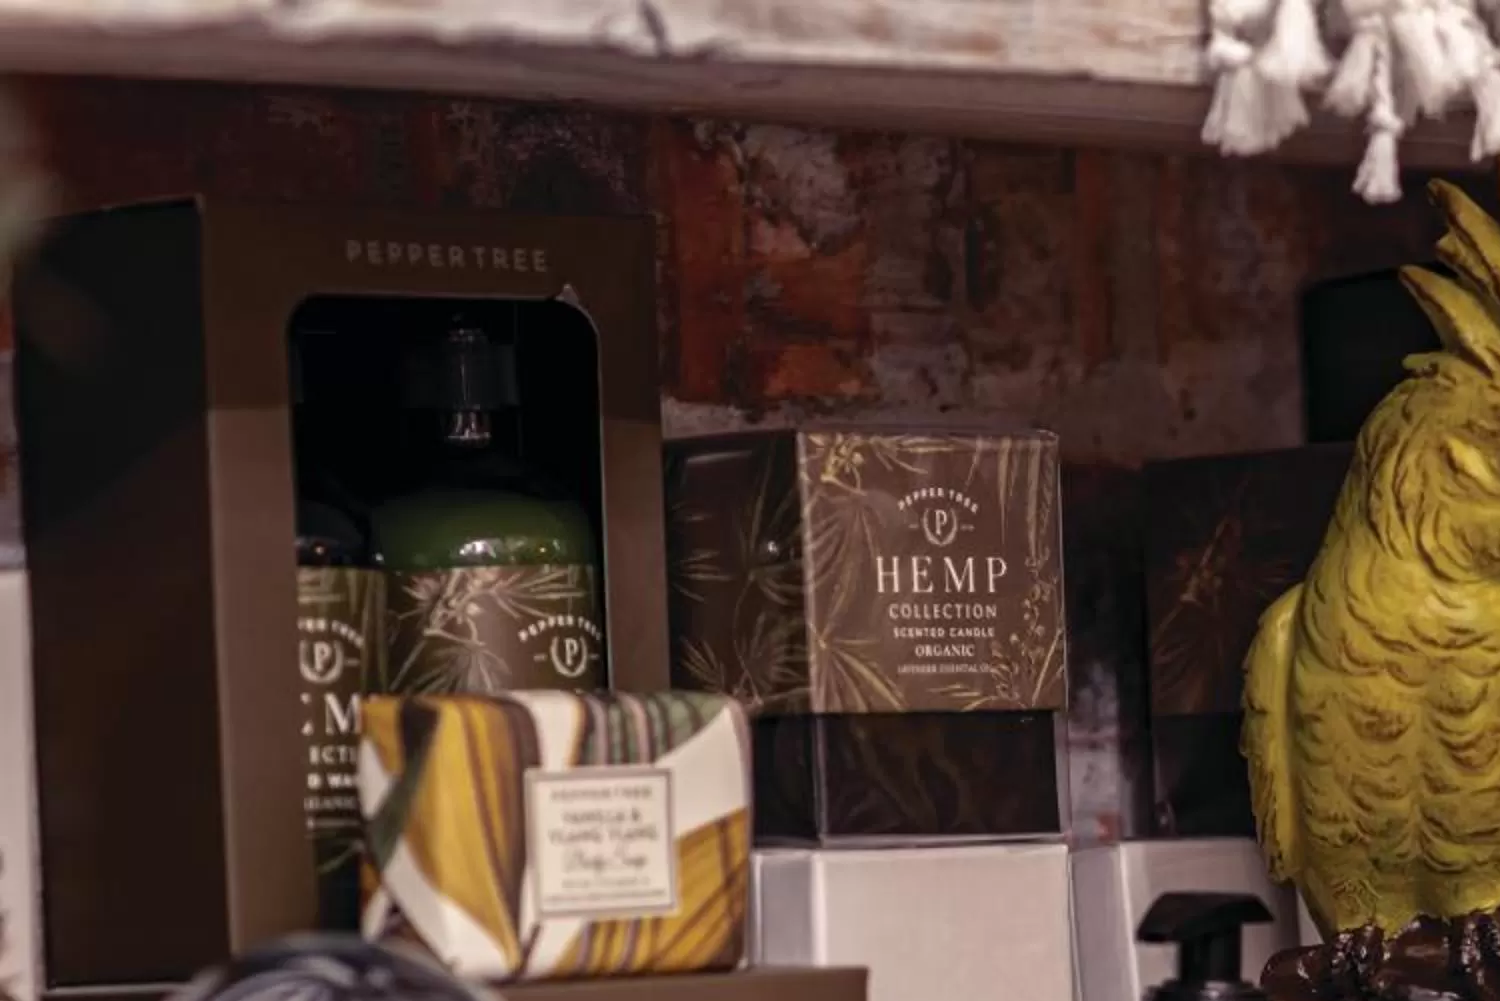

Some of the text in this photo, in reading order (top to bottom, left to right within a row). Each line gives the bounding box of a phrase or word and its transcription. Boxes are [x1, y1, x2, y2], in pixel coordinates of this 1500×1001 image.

[346, 239, 548, 272] PEPPERTREE
[876, 555, 1007, 593] HEMP
[889, 603, 997, 619] COLLECTION
[893, 627, 995, 638] SCENTED CANDLE
[914, 643, 976, 657] ORGANIC
